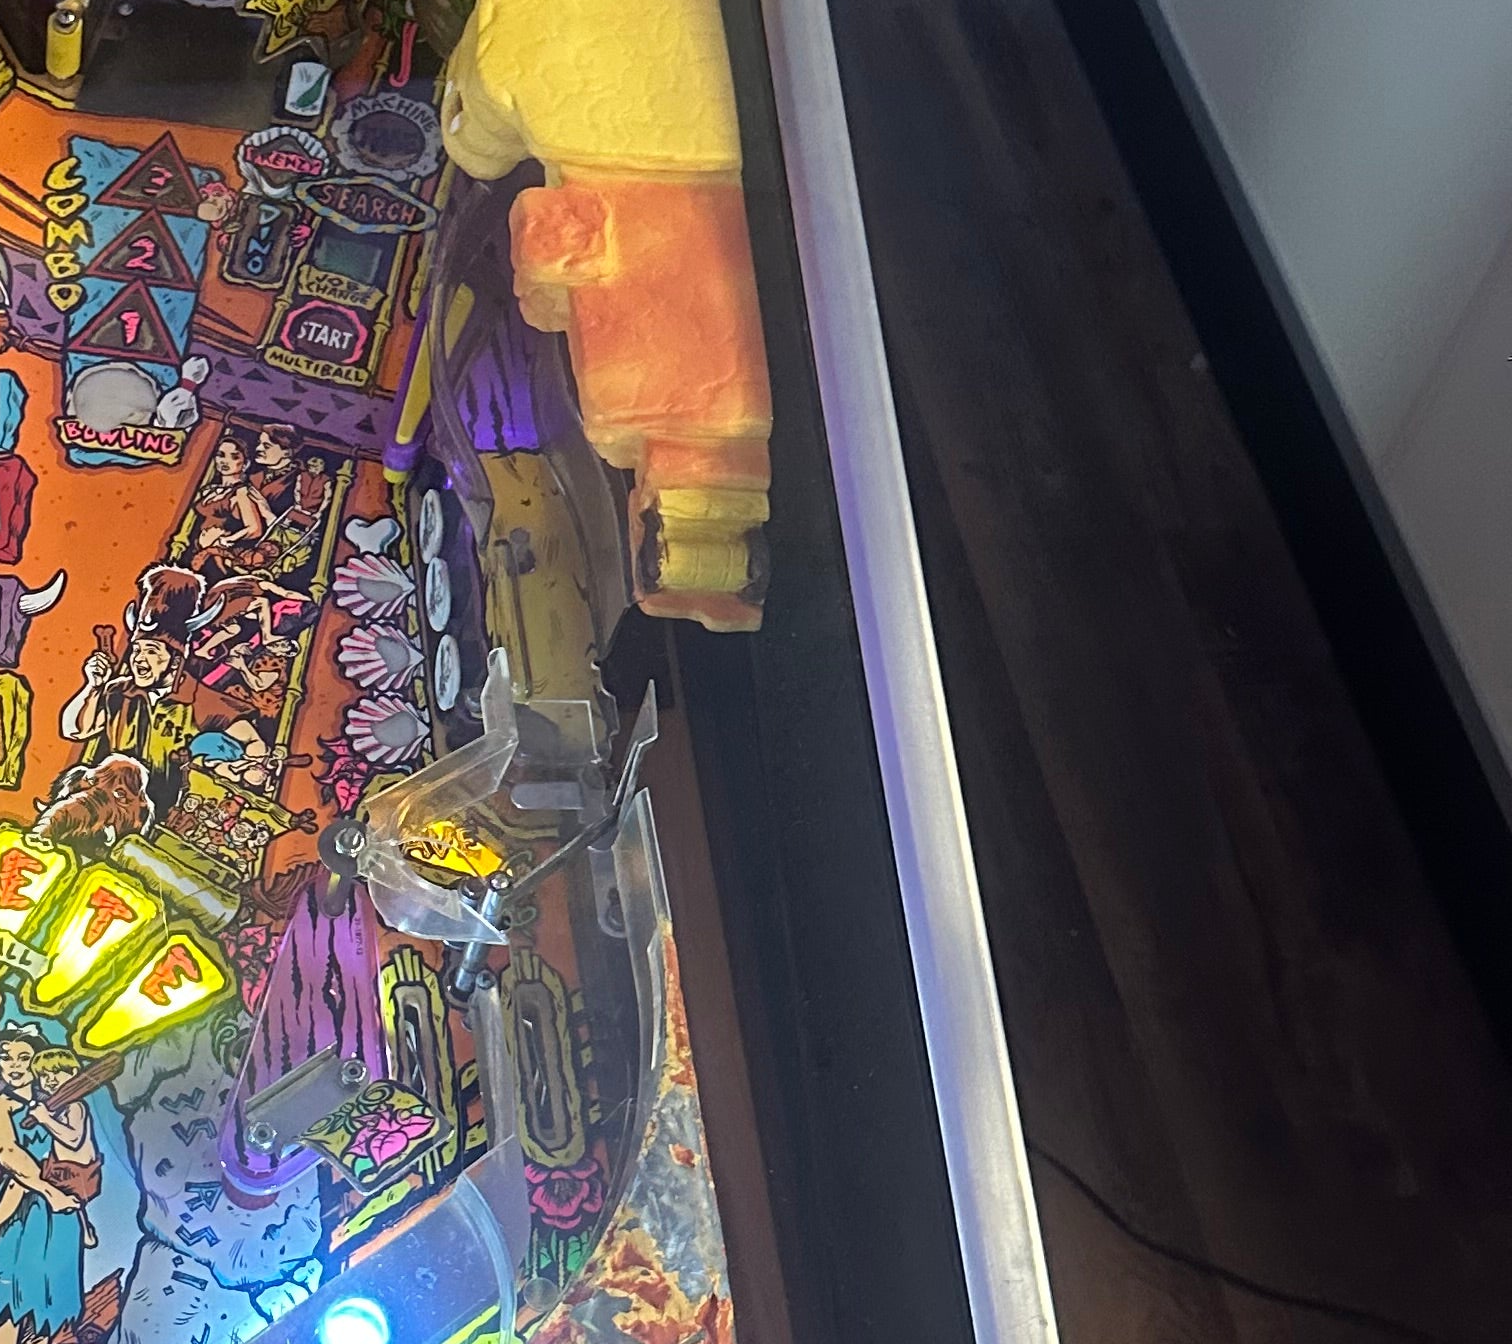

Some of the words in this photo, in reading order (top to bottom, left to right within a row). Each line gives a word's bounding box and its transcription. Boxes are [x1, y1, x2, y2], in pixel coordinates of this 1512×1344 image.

[350, 97, 440, 133] MACHINE
[245, 147, 322, 174] FRENZY
[150, 164, 175, 195] 3
[317, 184, 418, 226] SEARCH
[45, 156, 92, 311] COMBO
[247, 208, 274, 276] DINO
[129, 237, 161, 272] 2
[305, 282, 375, 307] CHANGE
[312, 273, 363, 292] JOB
[121, 309, 143, 345] 1
[296, 319, 354, 350] START
[268, 350, 367, 384] MULTIBALL
[63, 420, 180, 455] BOWLING
